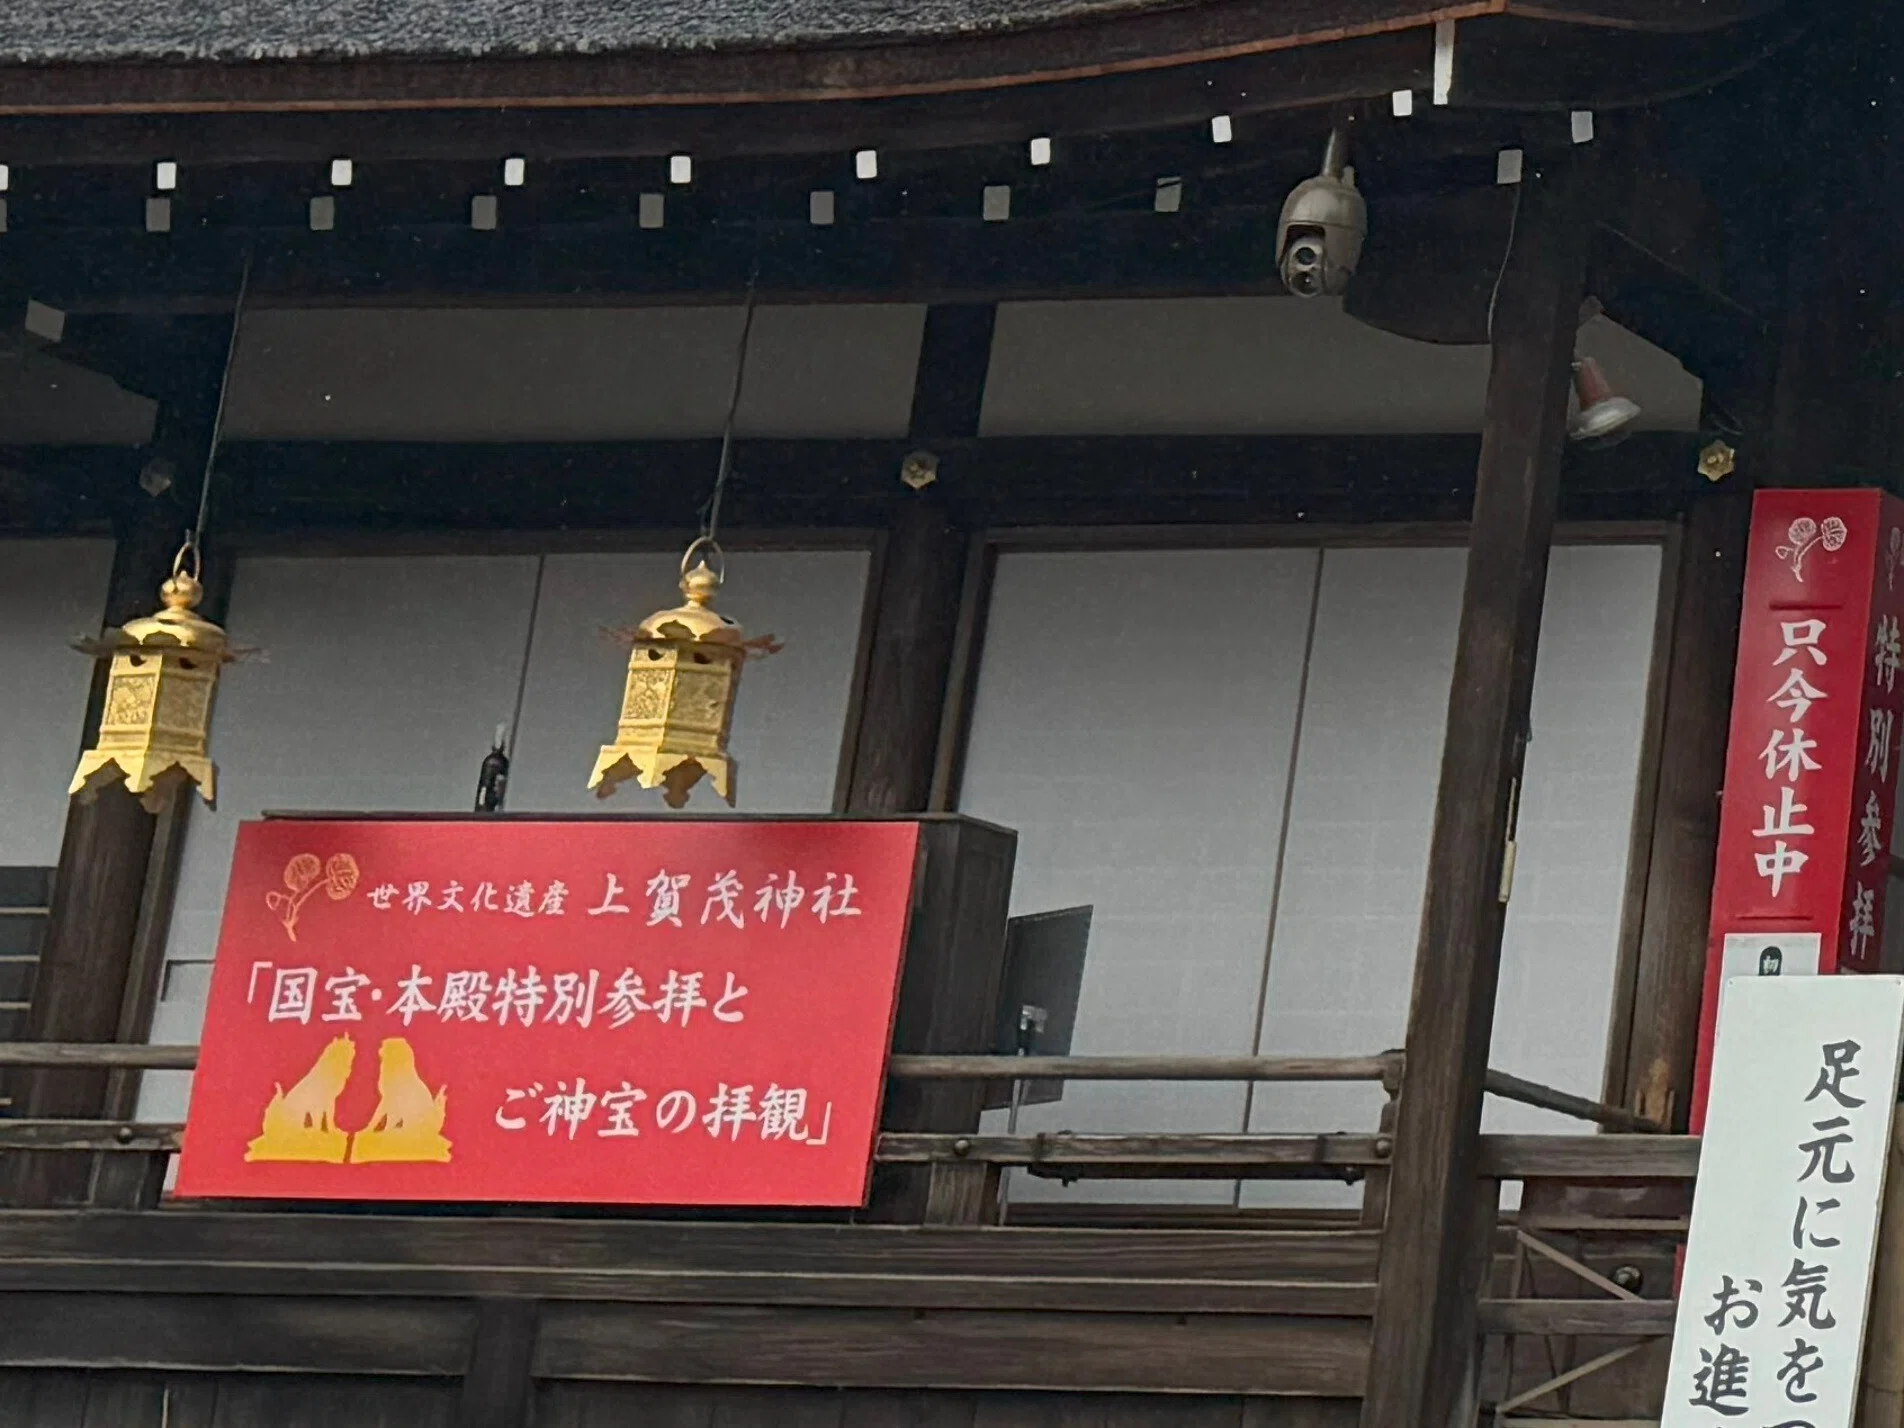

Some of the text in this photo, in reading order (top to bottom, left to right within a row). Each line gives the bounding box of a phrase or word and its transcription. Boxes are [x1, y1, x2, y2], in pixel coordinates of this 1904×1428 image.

[1752, 618, 1828, 898] 只今休止中
[1850, 613, 1901, 960] 特別参拝
[367, 869, 862, 930] 世界文化遺産 上賀茂神社
[246, 961, 749, 1029] 「国宝・本殿特別参拝と
[495, 1077, 832, 1146] ご神宝の拝観」
[1763, 1039, 1867, 1428] 足元に気を
